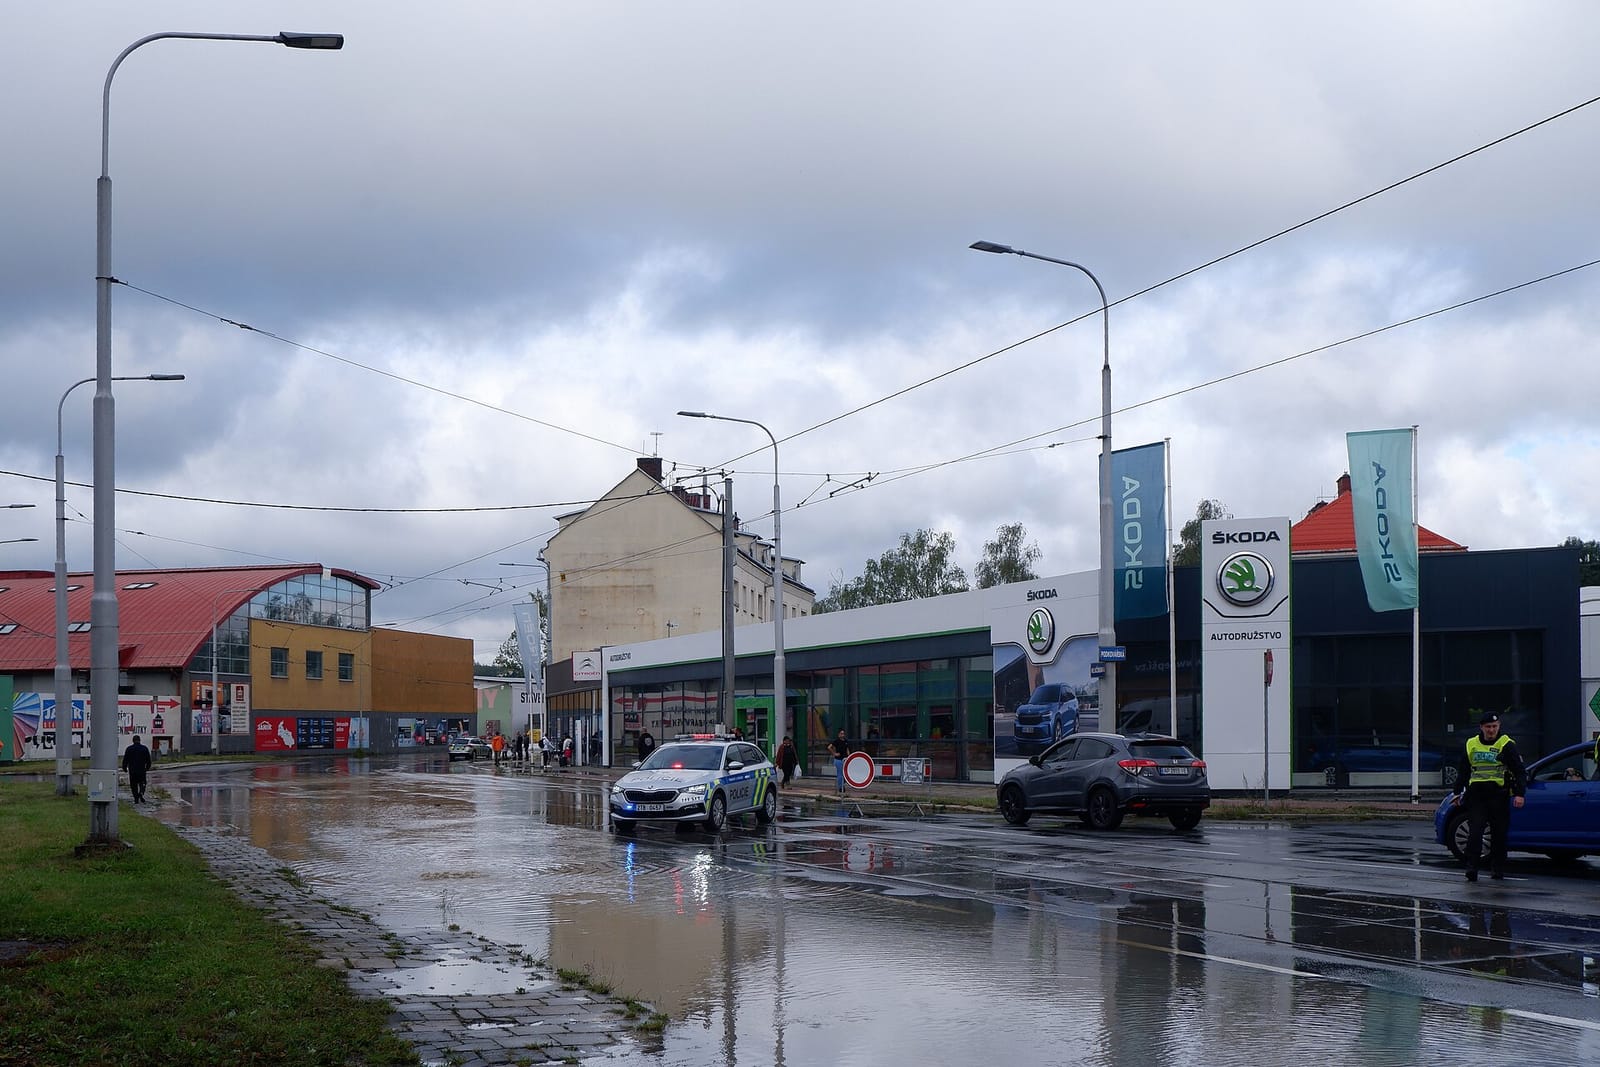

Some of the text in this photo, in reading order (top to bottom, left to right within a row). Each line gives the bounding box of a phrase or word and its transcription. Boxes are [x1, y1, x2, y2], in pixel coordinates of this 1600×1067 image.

[1212, 531, 1280, 544] ŠKODA
[1027, 589, 1058, 601] ŠKODA
[1211, 631, 1282, 641] AUTODRUŽSTVO
